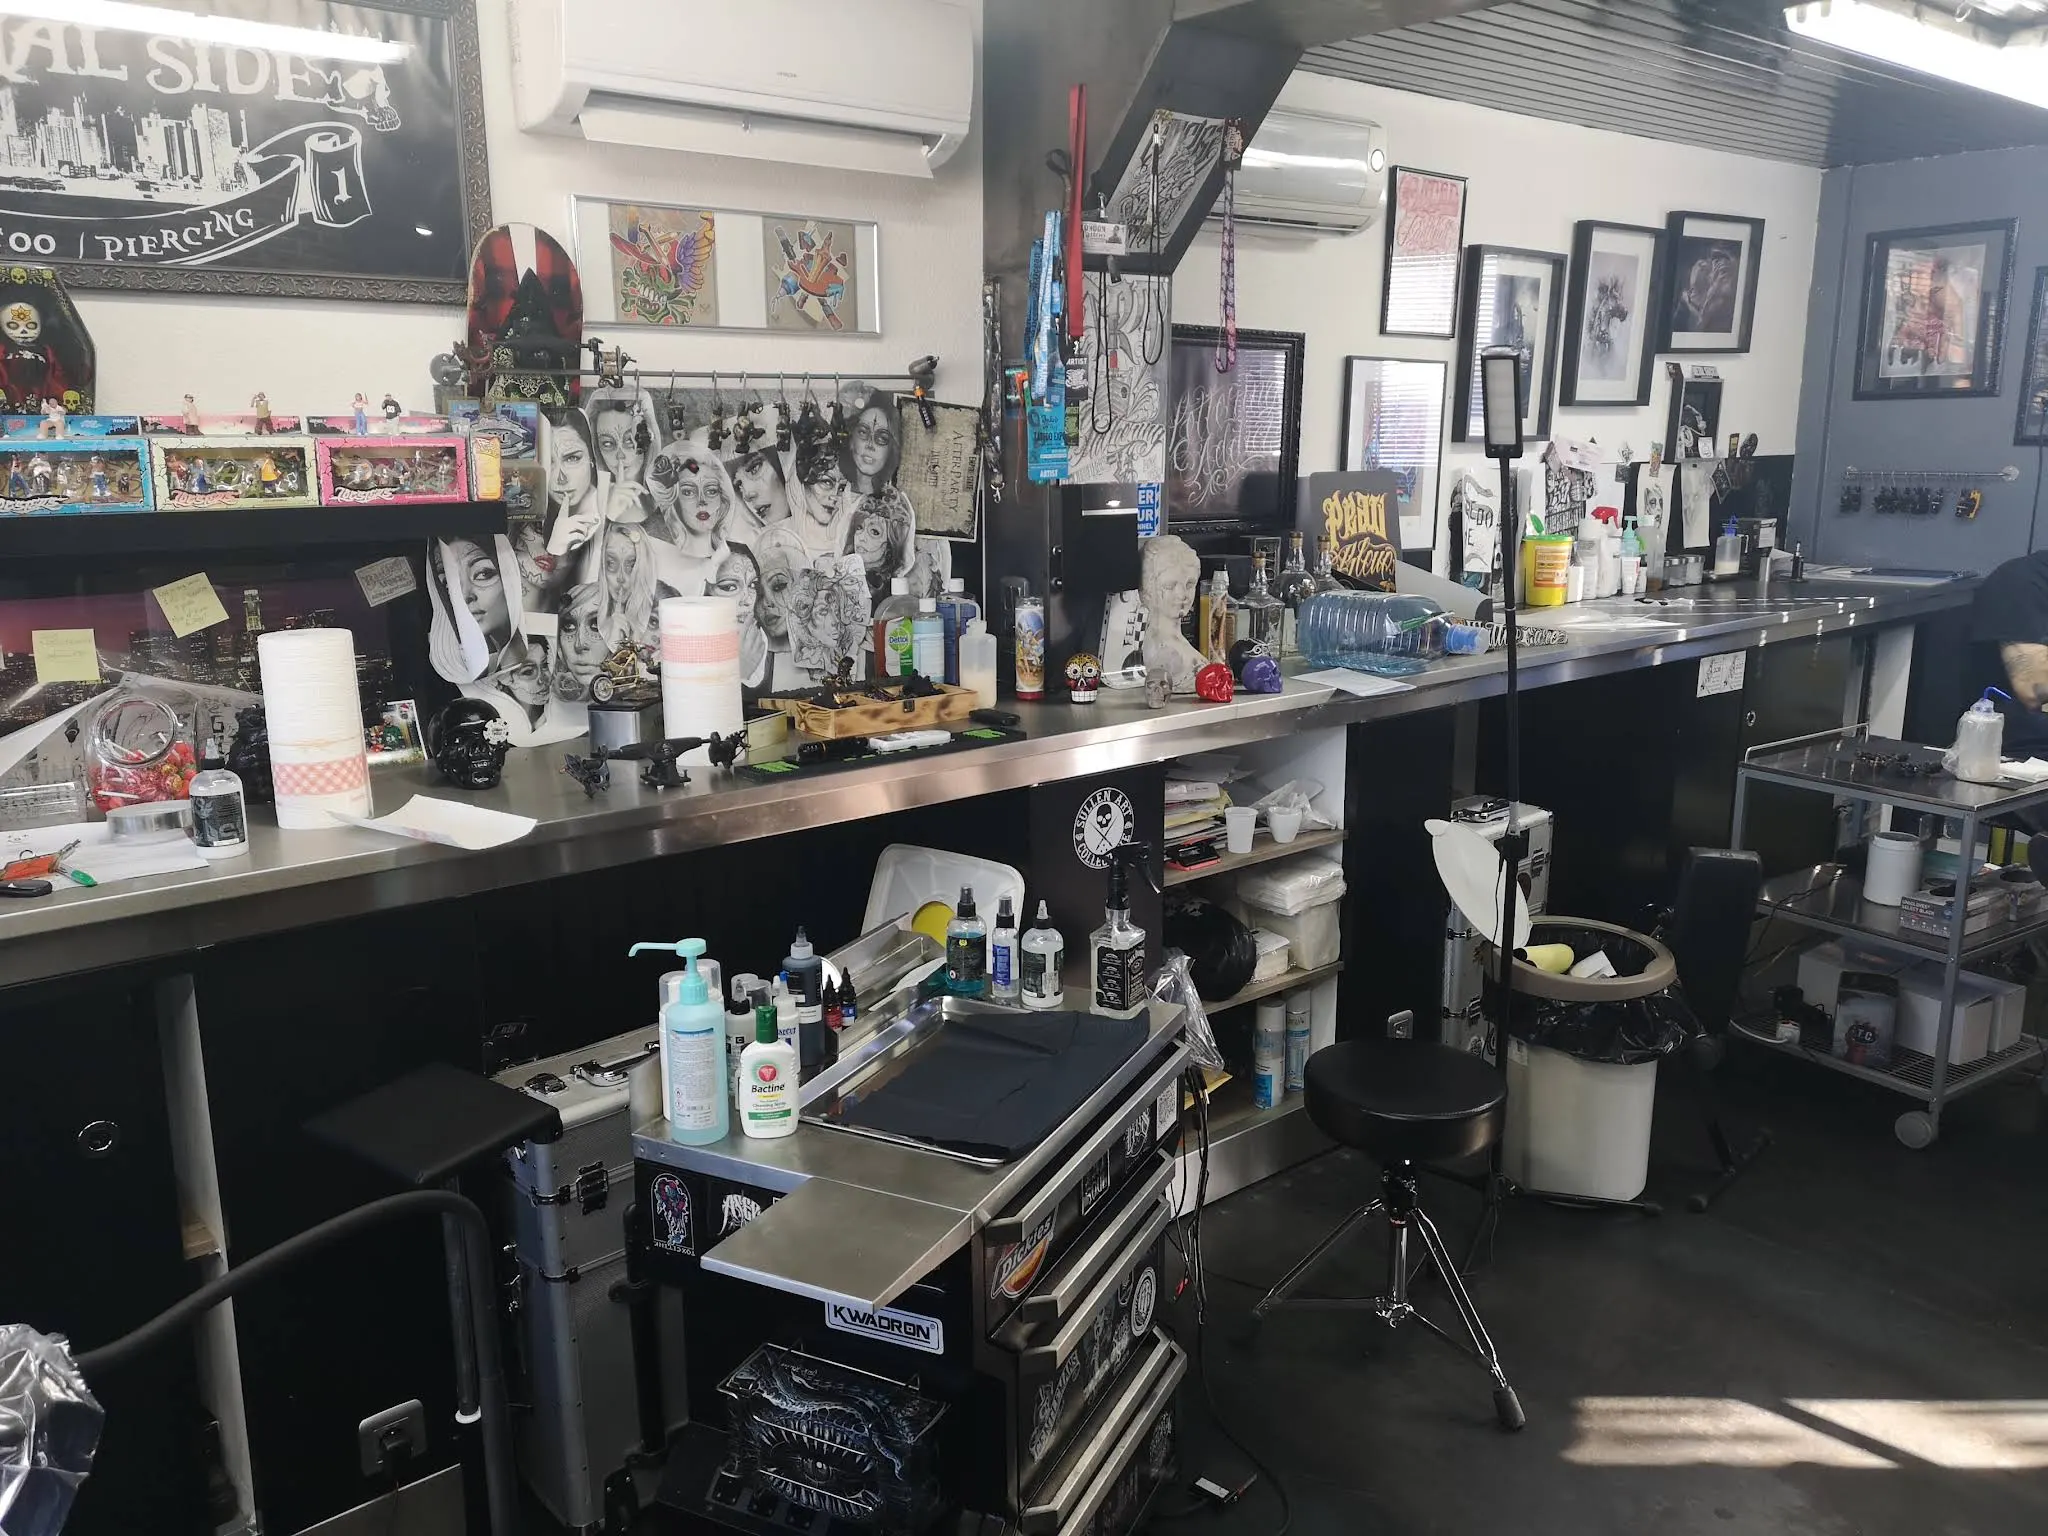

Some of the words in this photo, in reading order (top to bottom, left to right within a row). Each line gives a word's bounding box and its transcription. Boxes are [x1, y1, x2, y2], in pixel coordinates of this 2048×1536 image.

[145, 36, 333, 103] SIDE
[0, 227, 57, 255] OO
[95, 208, 254, 262] PIERCING
[1039, 469, 1058, 478] ARTIST
[889, 635, 909, 644] Dettol
[1076, 790, 1112, 829] SULLEN
[1114, 793, 1133, 816] ART
[751, 1083, 785, 1094] Bactine
[1000, 1215, 1053, 1282] Dickies
[833, 1304, 931, 1345] KWADRON
